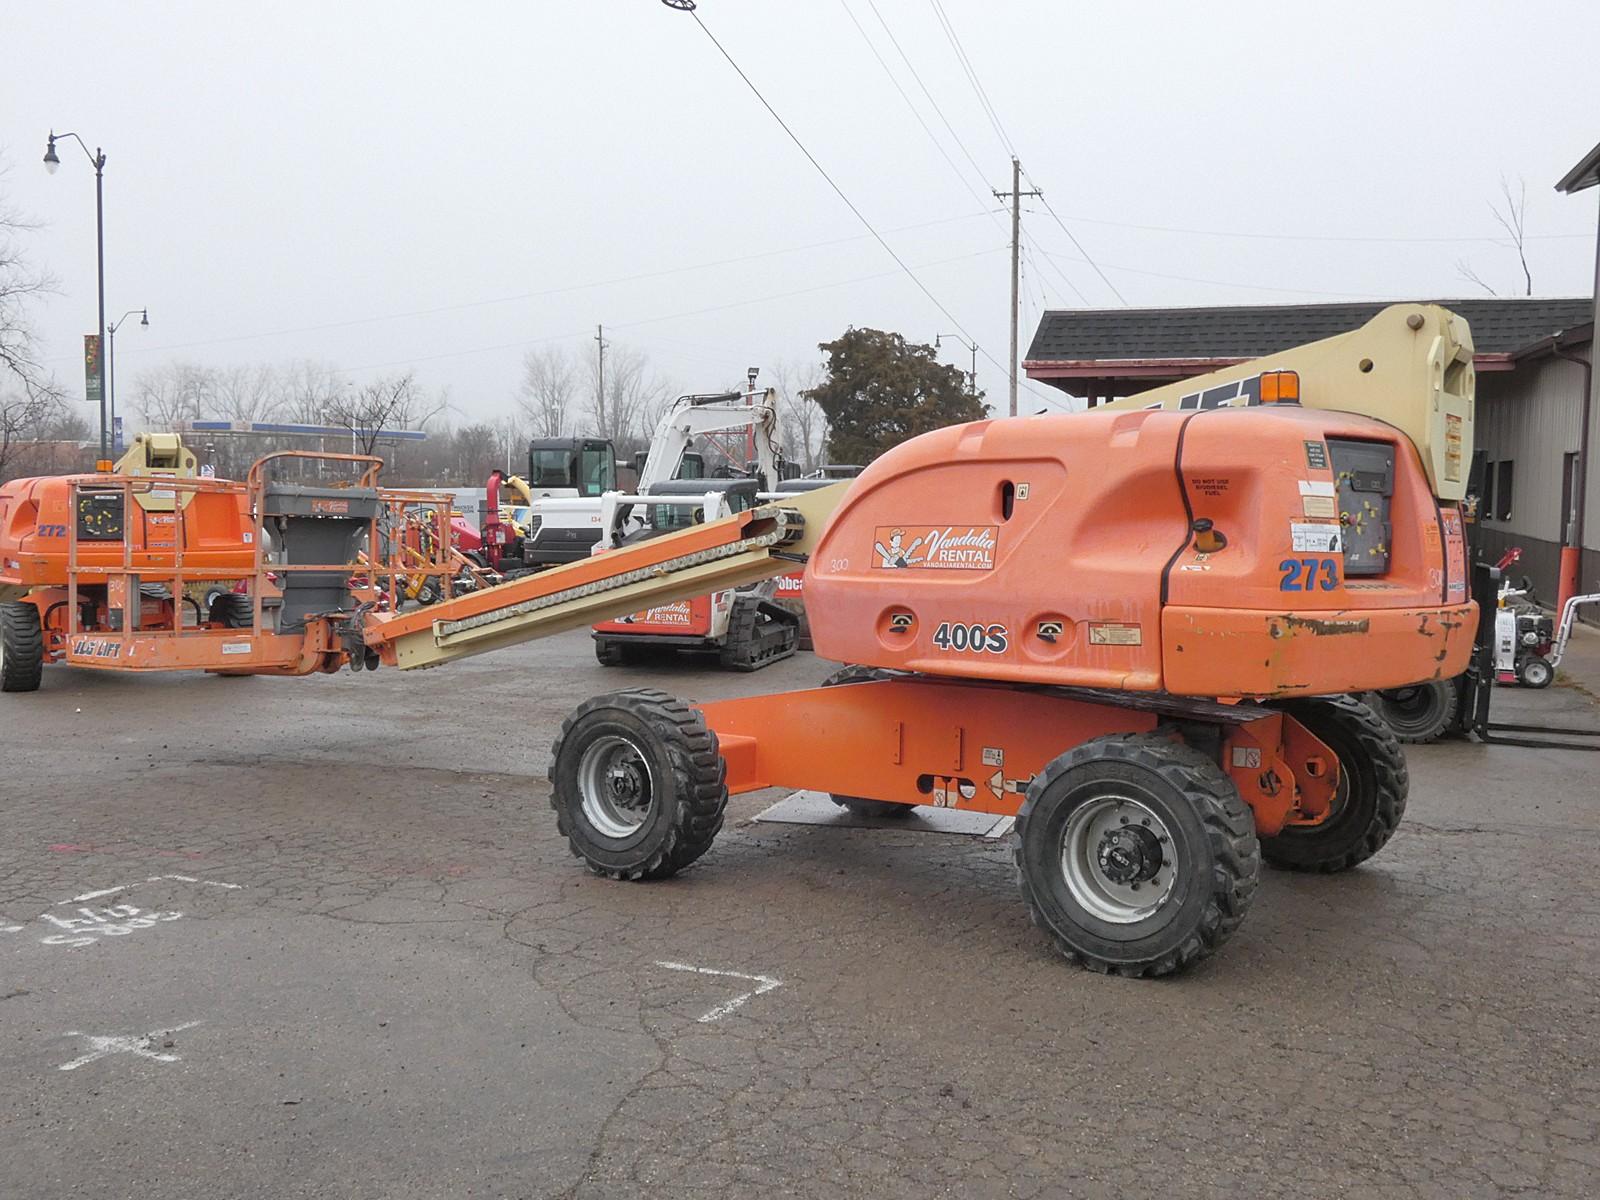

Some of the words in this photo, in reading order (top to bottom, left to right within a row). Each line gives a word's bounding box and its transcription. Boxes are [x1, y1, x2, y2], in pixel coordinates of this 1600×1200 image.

[38, 525, 66, 537] 272
[924, 527, 995, 561] Vandalia
[939, 549, 992, 562] RENTAL
[1279, 559, 1338, 592] 273
[646, 601, 691, 620] Vandalia
[654, 613, 689, 622] RENTAL
[933, 623, 1008, 653] 400S
[96, 641, 121, 657] LIFT
